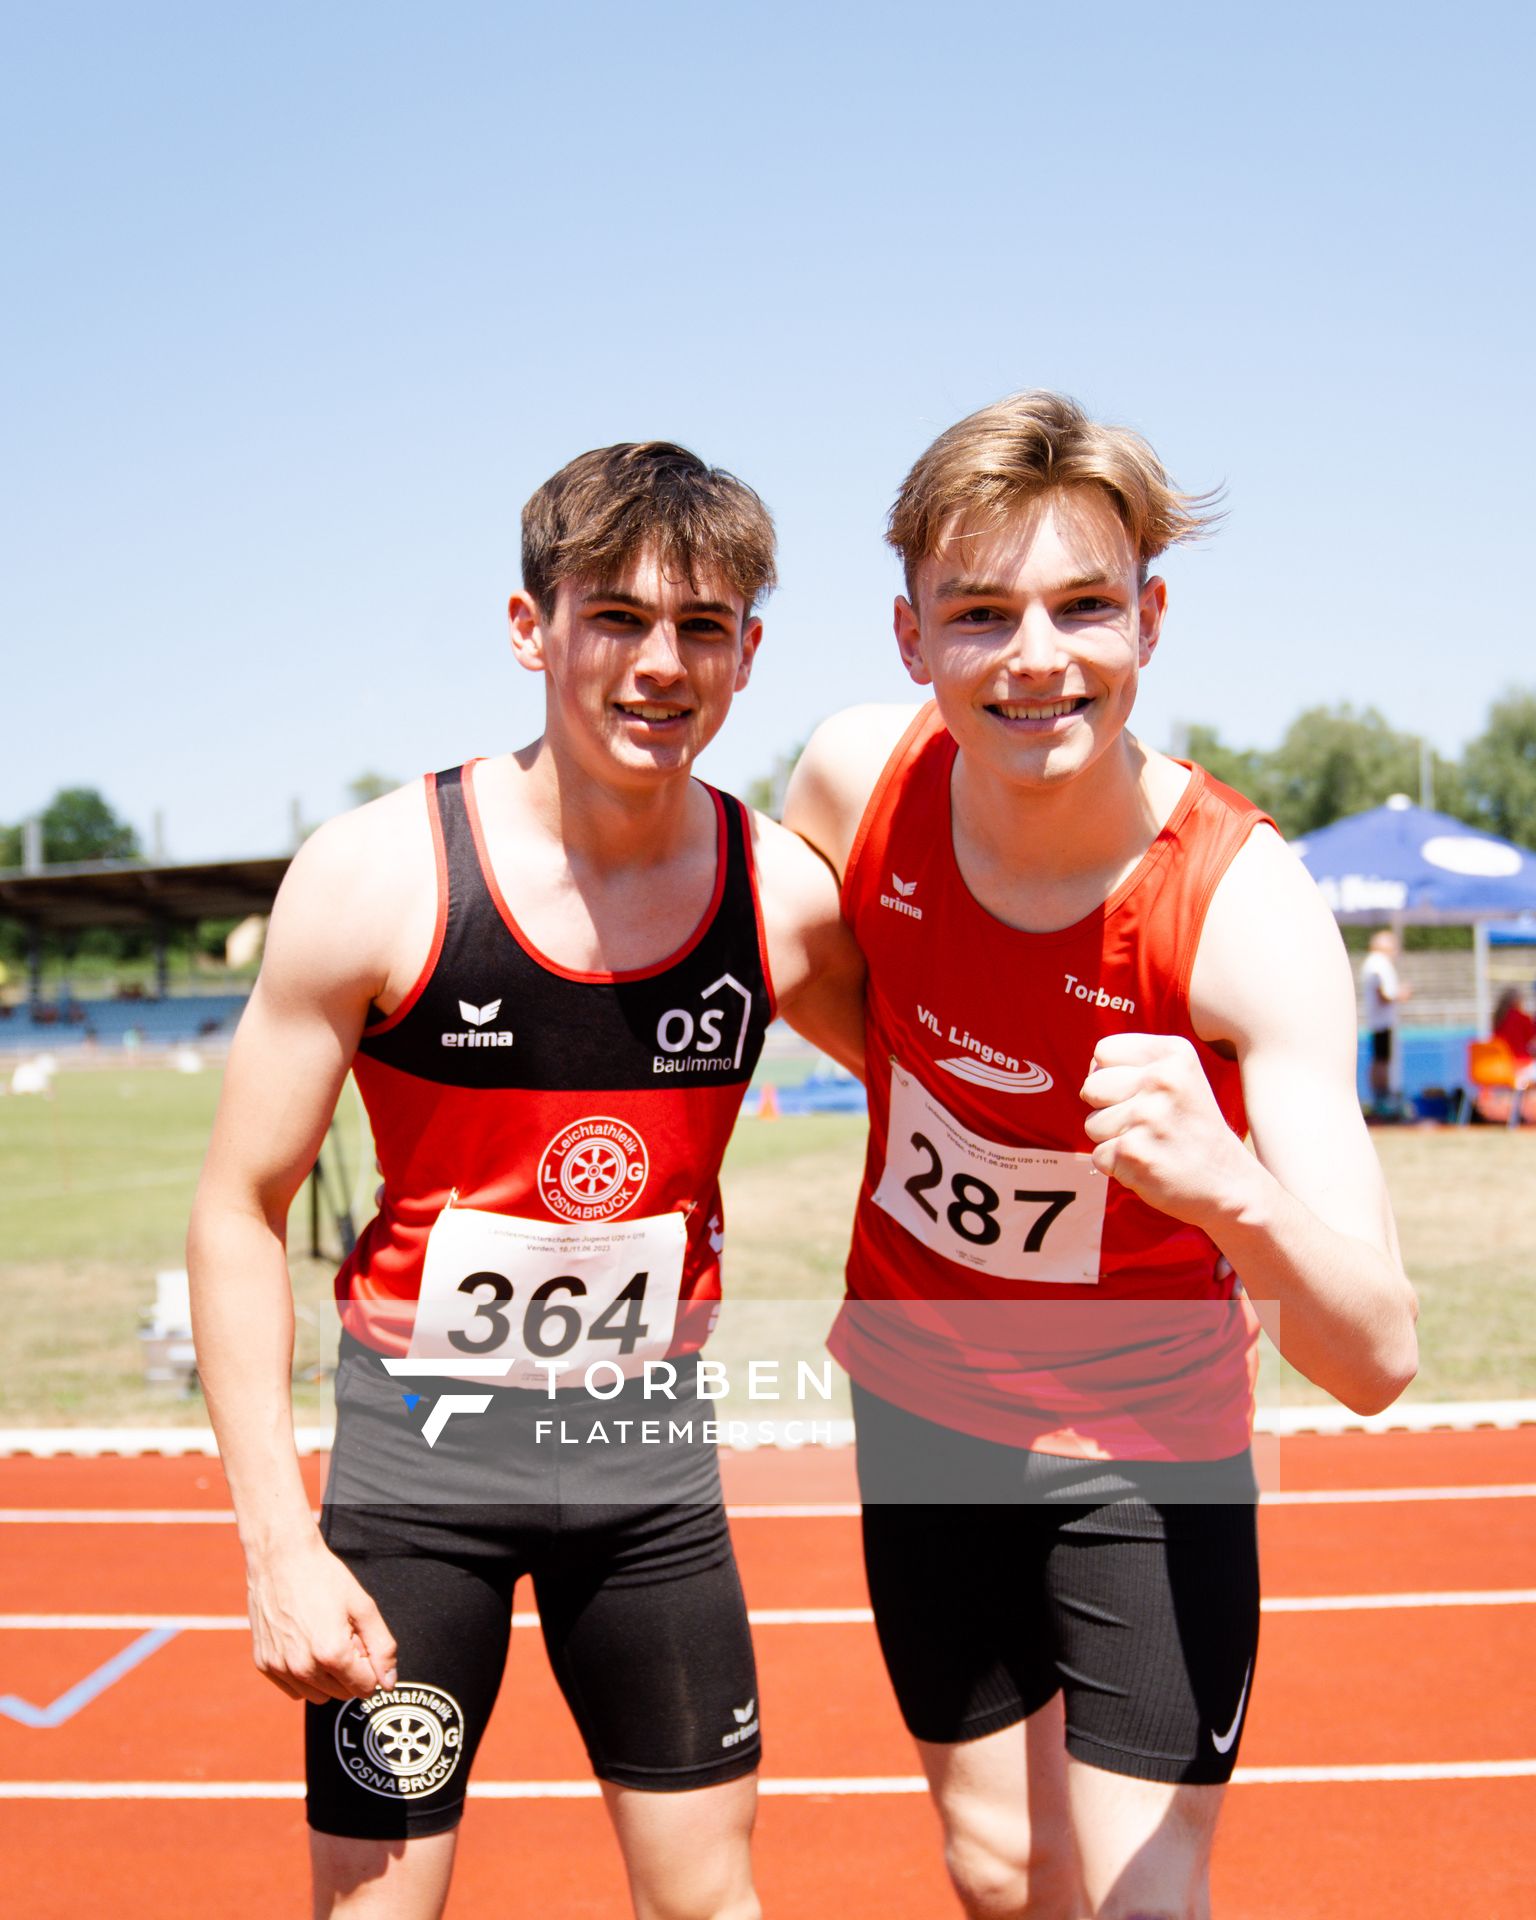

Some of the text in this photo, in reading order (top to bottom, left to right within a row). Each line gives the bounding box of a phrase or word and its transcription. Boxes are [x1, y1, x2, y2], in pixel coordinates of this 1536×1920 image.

[880, 894, 922, 920] erima
[1065, 974, 1135, 1014] Torben
[441, 1029, 513, 1047] erima
[656, 1008, 724, 1052] OS
[916, 1004, 1019, 1072] VfL Lingen
[653, 1055, 732, 1073] BauImmo
[552, 1124, 638, 1157] Leichtathletik
[544, 1162, 644, 1183] L G
[988, 1151, 1015, 1163] Jugend
[547, 1188, 633, 1219] OSNABRÜCK
[905, 1132, 1077, 1253] 287
[582, 1235, 610, 1243] Jugend
[447, 1271, 649, 1357] 364
[349, 1690, 453, 1722] Leichtathletik
[342, 1727, 459, 1749] L G
[349, 1755, 453, 1793] OSNABRÜCK
